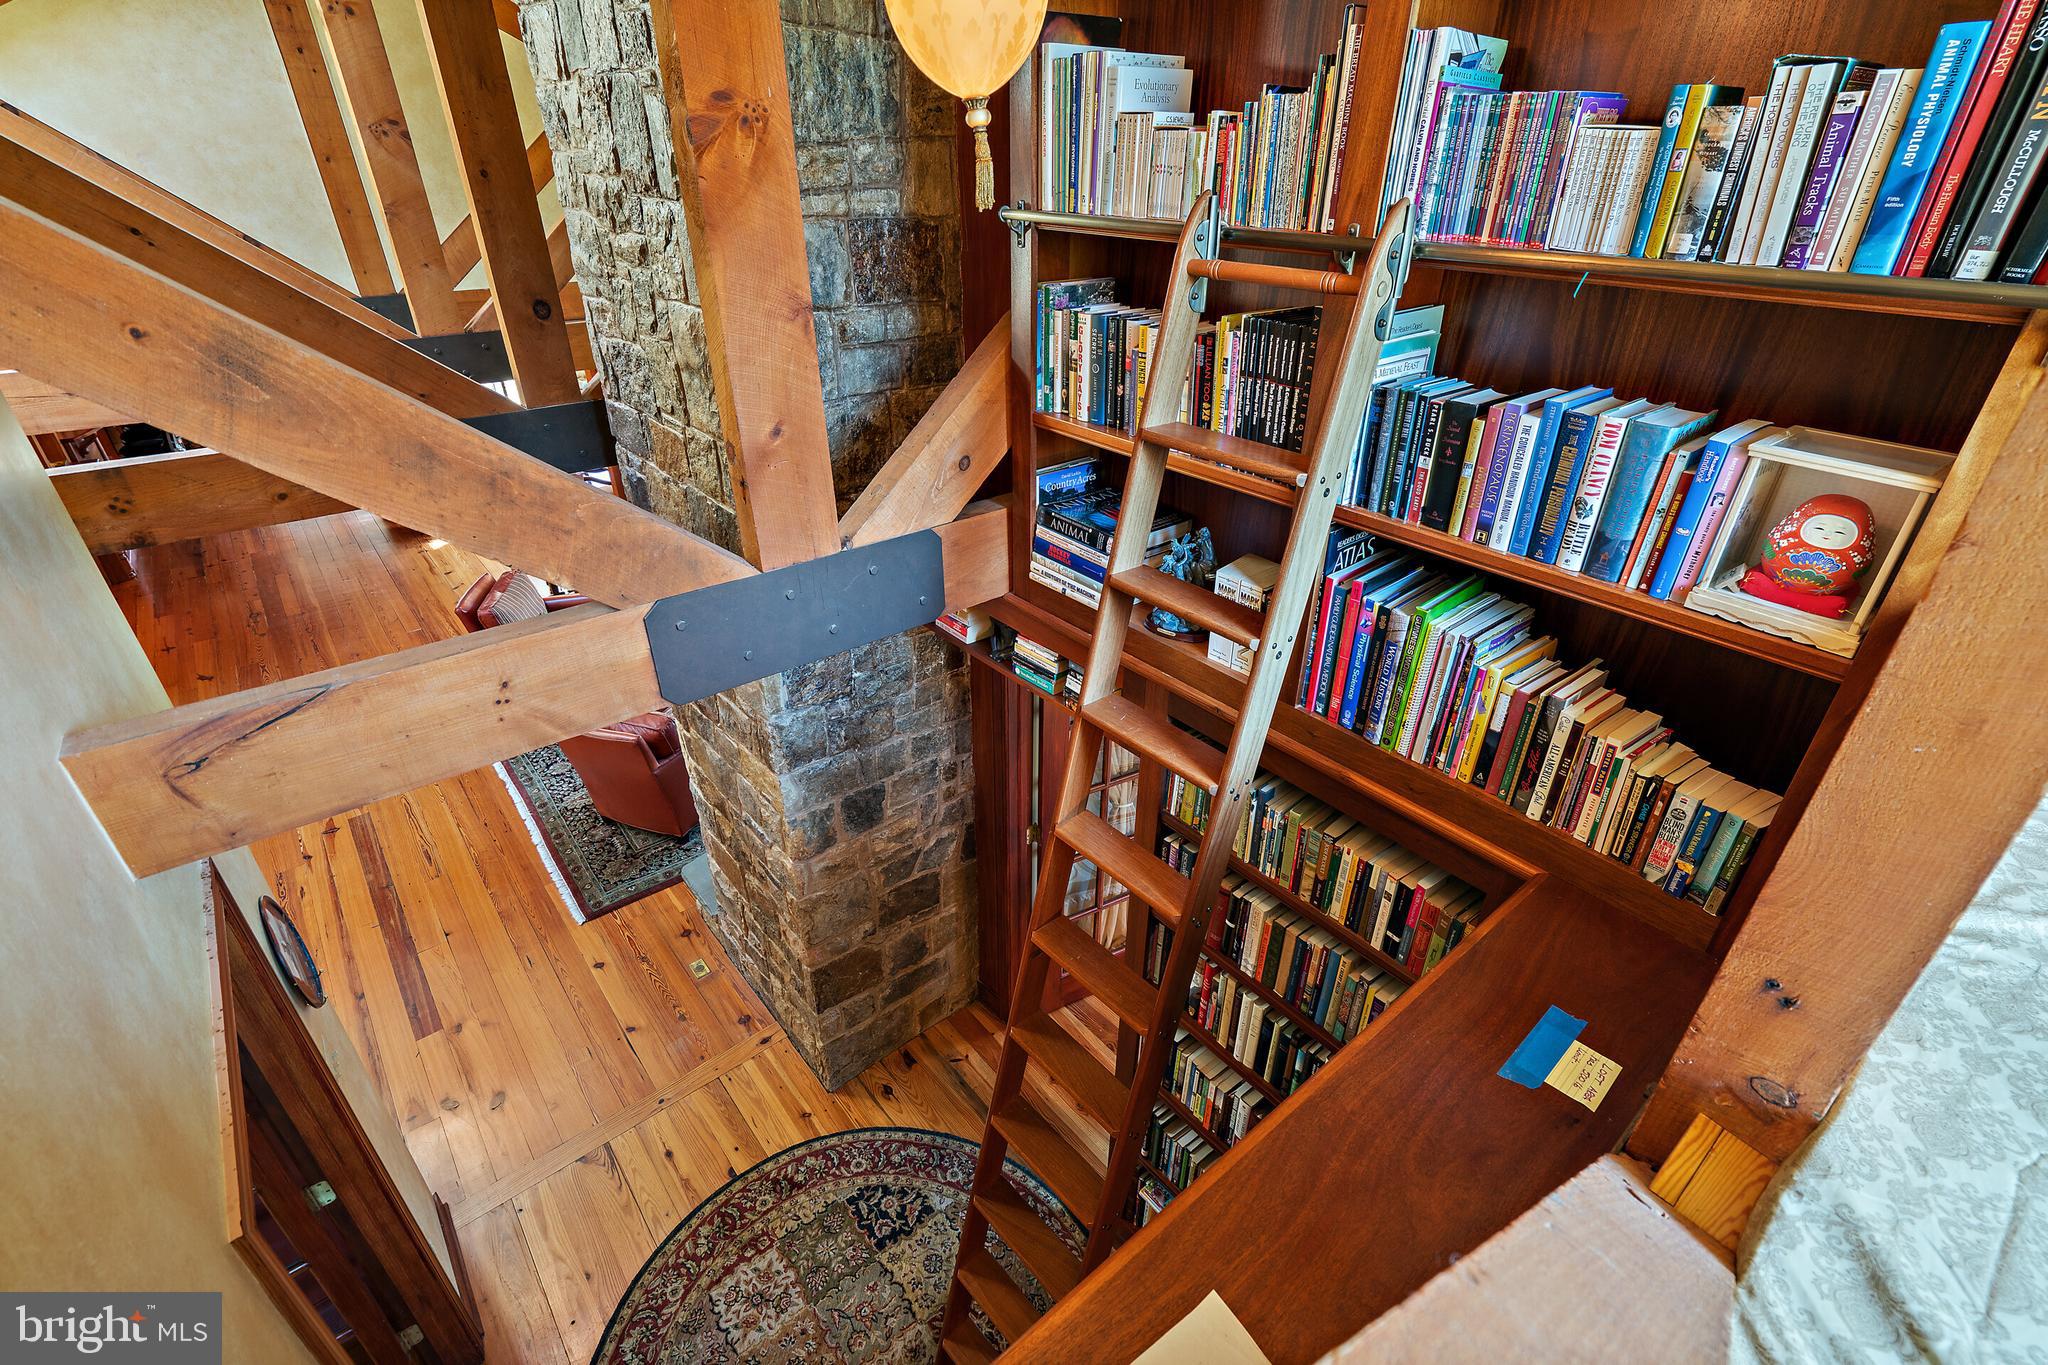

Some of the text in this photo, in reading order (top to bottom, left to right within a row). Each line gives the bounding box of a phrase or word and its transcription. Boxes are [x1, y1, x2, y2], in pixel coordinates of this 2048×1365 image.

[1989, 1, 2036, 77] HE HEART
[1349, 52, 1357, 81] BREAD
[1934, 37, 1972, 115] Schmidt-Nielsen
[1134, 78, 1179, 94] Evolutionary
[1141, 92, 1171, 106] Analysis
[1343, 84, 1353, 123] MACHINE
[1761, 82, 1784, 139] THE HOBBIT
[1791, 83, 1816, 147] OF THE KING
[1799, 82, 1826, 148] THE RETURN
[1900, 38, 1960, 167] ANIMAL PHYSIOLOGY
[1416, 118, 1426, 144] CALVIN
[1770, 82, 1800, 168] THE TWO TOWERS
[1330, 135, 1338, 170] COOKING
[1728, 142, 1745, 171] DUMBEST
[1821, 79, 1890, 241] THE GOOD MOTHER SUE MILLER
[1407, 163, 1417, 191] HOBBES
[1801, 122, 1844, 217] Animal Tracks
[1863, 168, 1880, 194] PETER
[1989, 129, 2041, 214] McCULLOUGH
[1716, 172, 1735, 207] CRIMINALS
[1852, 196, 1869, 223] MAYLE
[1917, 172, 1959, 249] The Human Body
[1136, 360, 1146, 384] SINGER
[1203, 346, 1212, 378] LILLIAN
[1294, 314, 1319, 448] ANNIE LEIBOVI
[1428, 404, 1438, 425] PEARL
[1422, 438, 1432, 455] BUCK
[1599, 423, 1622, 450] TOM
[1484, 411, 1517, 502] PERIMENOPAUSE
[1537, 446, 1546, 458] The
[1695, 449, 1714, 483] Handbook
[1045, 472, 1096, 492] Country Acres
[1498, 423, 1532, 522] THE CONCEALED HANDGUN MANUAL
[1526, 459, 1545, 502] Tenderness
[1704, 454, 1719, 482] Reader's
[1538, 446, 1578, 535] CRIMINAL PERSONALITY
[1050, 518, 1090, 544] ANIMAL
[1518, 511, 1531, 538] Wolves
[1562, 520, 1578, 551] READY
[1571, 523, 1590, 556] BATTLE
[1332, 536, 1376, 573] ATLAS
[1682, 549, 1701, 579] Mythology
[1043, 571, 1062, 583] HISTORY
[1066, 582, 1076, 590] THE
[1075, 586, 1096, 600] MACHINE
[1218, 582, 1236, 596] MARK
[1240, 591, 1260, 605] MARK
[1332, 594, 1342, 614] FAMILY
[1328, 615, 1338, 634] GUIDE
[1406, 615, 1423, 654] GUINNESS
[1323, 640, 1334, 666] NATURAL
[1346, 633, 1367, 699] Physical Science
[1318, 668, 1329, 696] MEDICINE
[1372, 645, 1397, 710] WORLD HISTORY
[1398, 655, 1412, 682] WORLD
[1390, 682, 1405, 715] RECORDS
[1594, 747, 1614, 792] HOTEL PASTIS
[1638, 803, 1650, 821] CAMUS
[1664, 818, 1684, 832] BLIND
[1662, 825, 1681, 838] MAN'S
[1578, 1069, 1590, 1082] 500
[1595, 1063, 1613, 1086] LOFT
